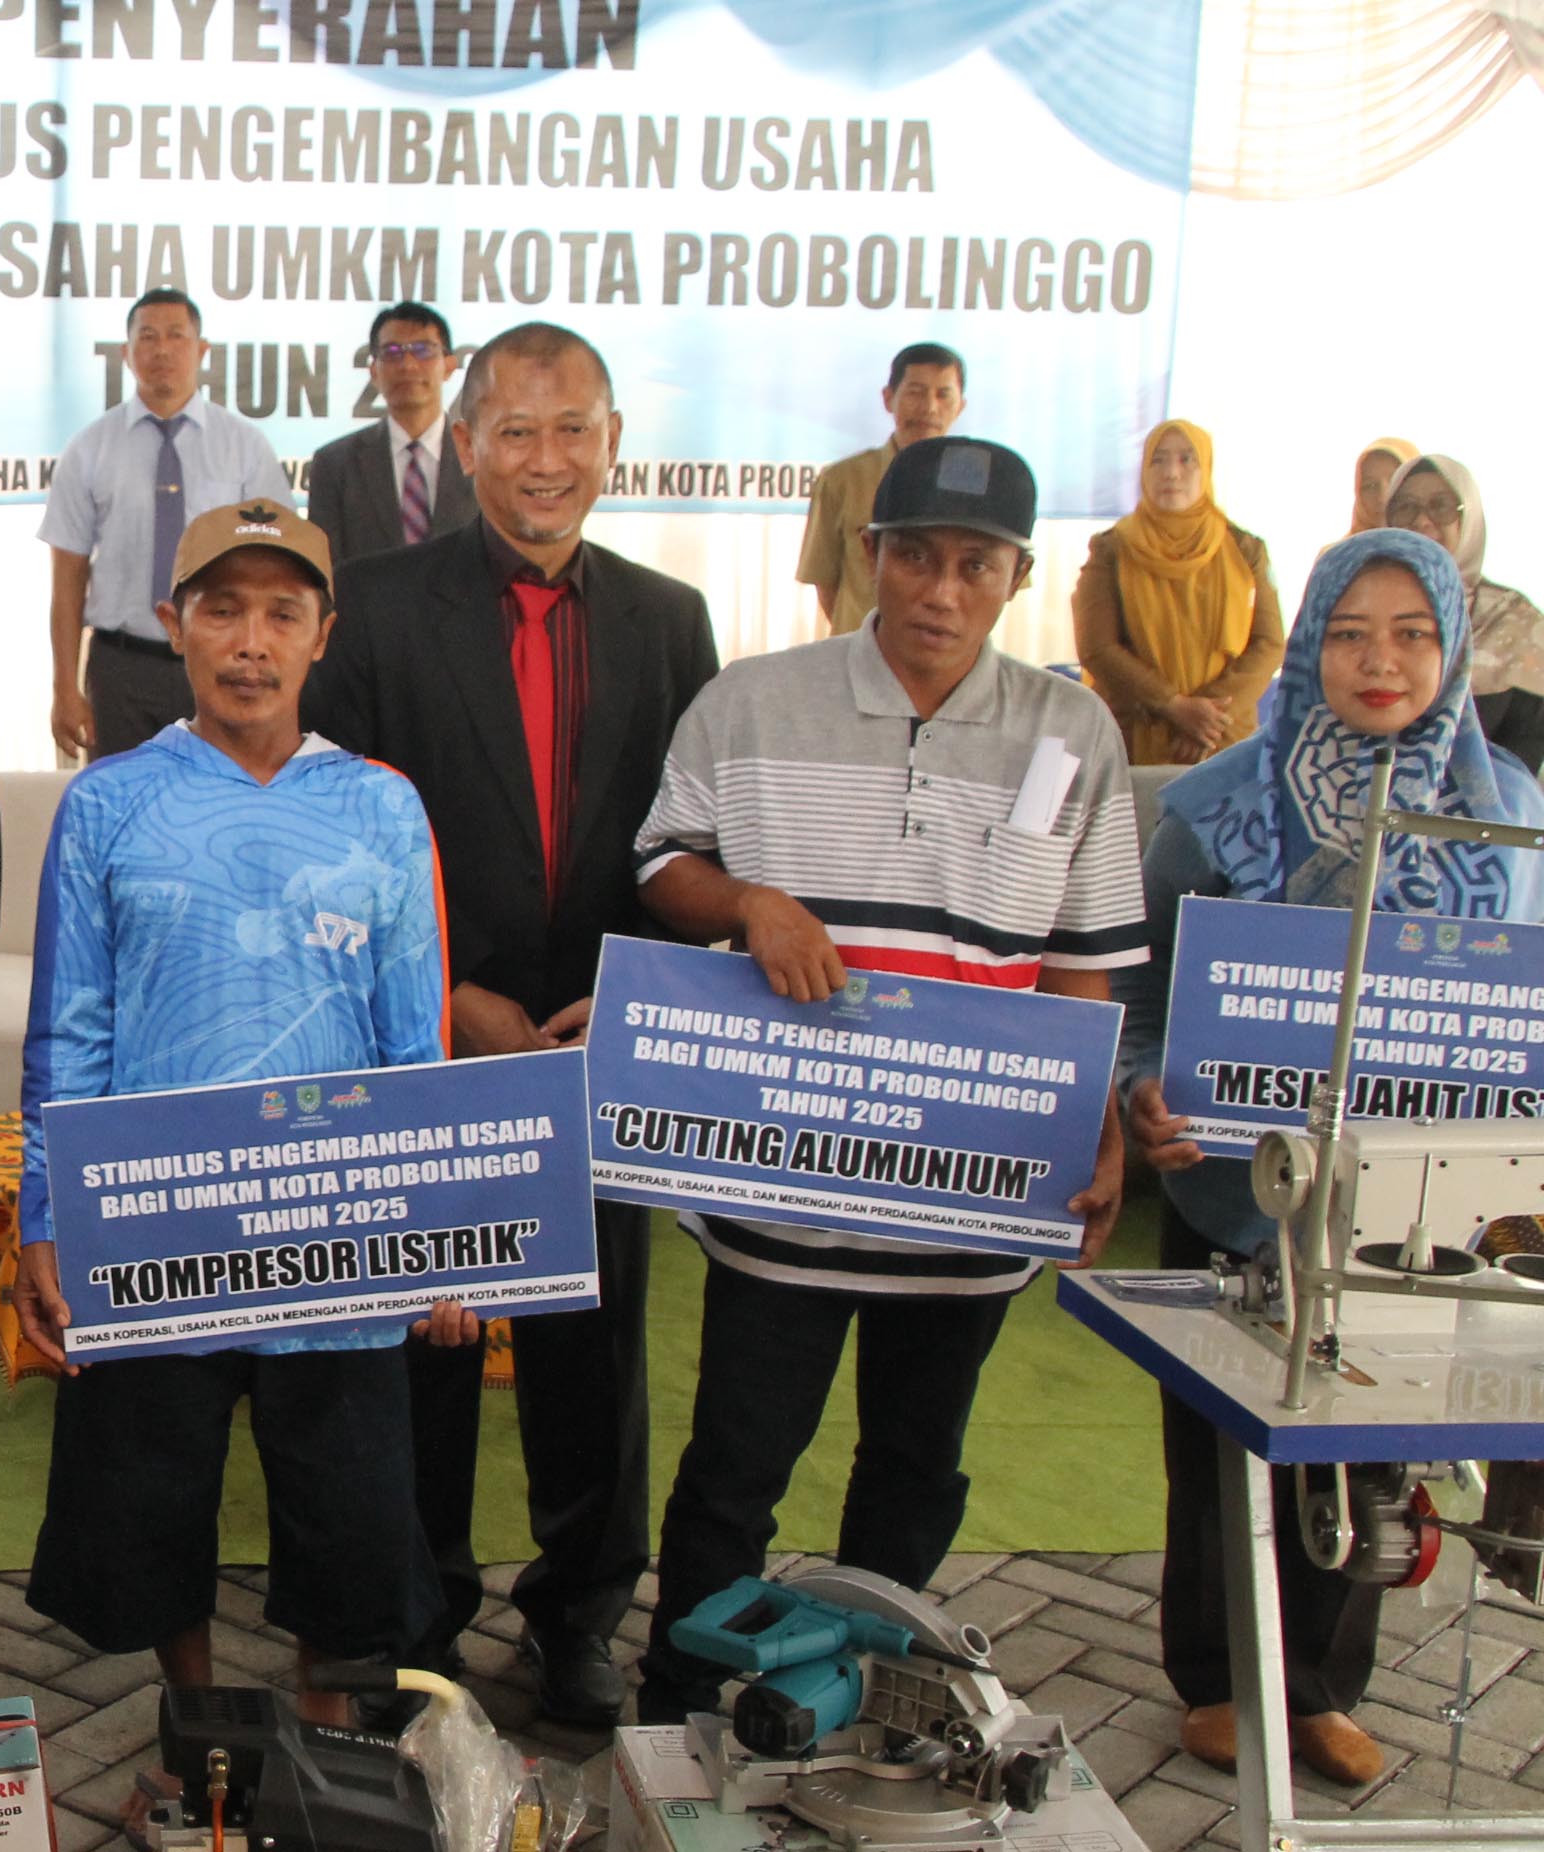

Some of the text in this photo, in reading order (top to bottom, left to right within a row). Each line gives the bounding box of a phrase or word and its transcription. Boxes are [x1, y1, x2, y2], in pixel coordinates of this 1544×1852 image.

[92, 103, 679, 189] PENGEMBANGAN
[701, 116, 936, 192] USAHA
[211, 225, 440, 302] UMKM
[461, 228, 641, 305] KOTA
[662, 232, 1154, 315] PROBOLINGGO
[94, 341, 330, 419] THUN
[657, 462, 731, 497] KOTA
[234, 523, 282, 537] adidas
[1209, 960, 1345, 995] STIMULUS
[623, 999, 1079, 1086] STIMULUS PENGEMBANGAN USAHA
[1219, 993, 1289, 1022] BAGI
[1294, 1000, 1385, 1030] UMM
[1389, 1007, 1462, 1037] KOTA
[632, 1034, 1059, 1117] BAGI UMKM KOTA PROBOLINGGO
[1353, 1037, 1529, 1075] TAHUN 2025
[758, 1085, 925, 1132] TAHUN 2025
[1350, 1073, 1470, 1119] JAHIT
[81, 1114, 556, 1189] STIMULUS PENGEMBANGAN USAHA
[99, 1148, 542, 1221] BAGI UMKM KOTA PROBOLINGGO
[599, 1105, 1047, 1200] “CUTTING ALUMUNIUM”
[236, 1194, 409, 1238] TAHUN 2025
[613, 1171, 674, 1189] KOPERASI,
[676, 1179, 715, 1193] USAHA
[716, 1185, 749, 1199] KECIL
[751, 1189, 777, 1202] DAN
[777, 1193, 842, 1211] MENENGAH
[843, 1201, 868, 1214] DAN
[869, 1205, 956, 1226] PERDAGANGAN
[956, 1217, 988, 1230] KOTA
[989, 1221, 1072, 1241] PROBOLINGGO
[89, 1220, 537, 1307] “KOMPRESOR LISTRIK”
[75, 1331, 111, 1345] DINAS
[112, 1325, 176, 1341] KOPERASI,
[177, 1319, 218, 1334] USAHA
[218, 1315, 254, 1328] KECIL
[254, 1312, 280, 1324] DAN
[281, 1304, 348, 1321] MENENGAH
[349, 1301, 375, 1314] DAN
[467, 1289, 500, 1301] KOTA
[500, 1280, 587, 1298] PROBOLINGGO
